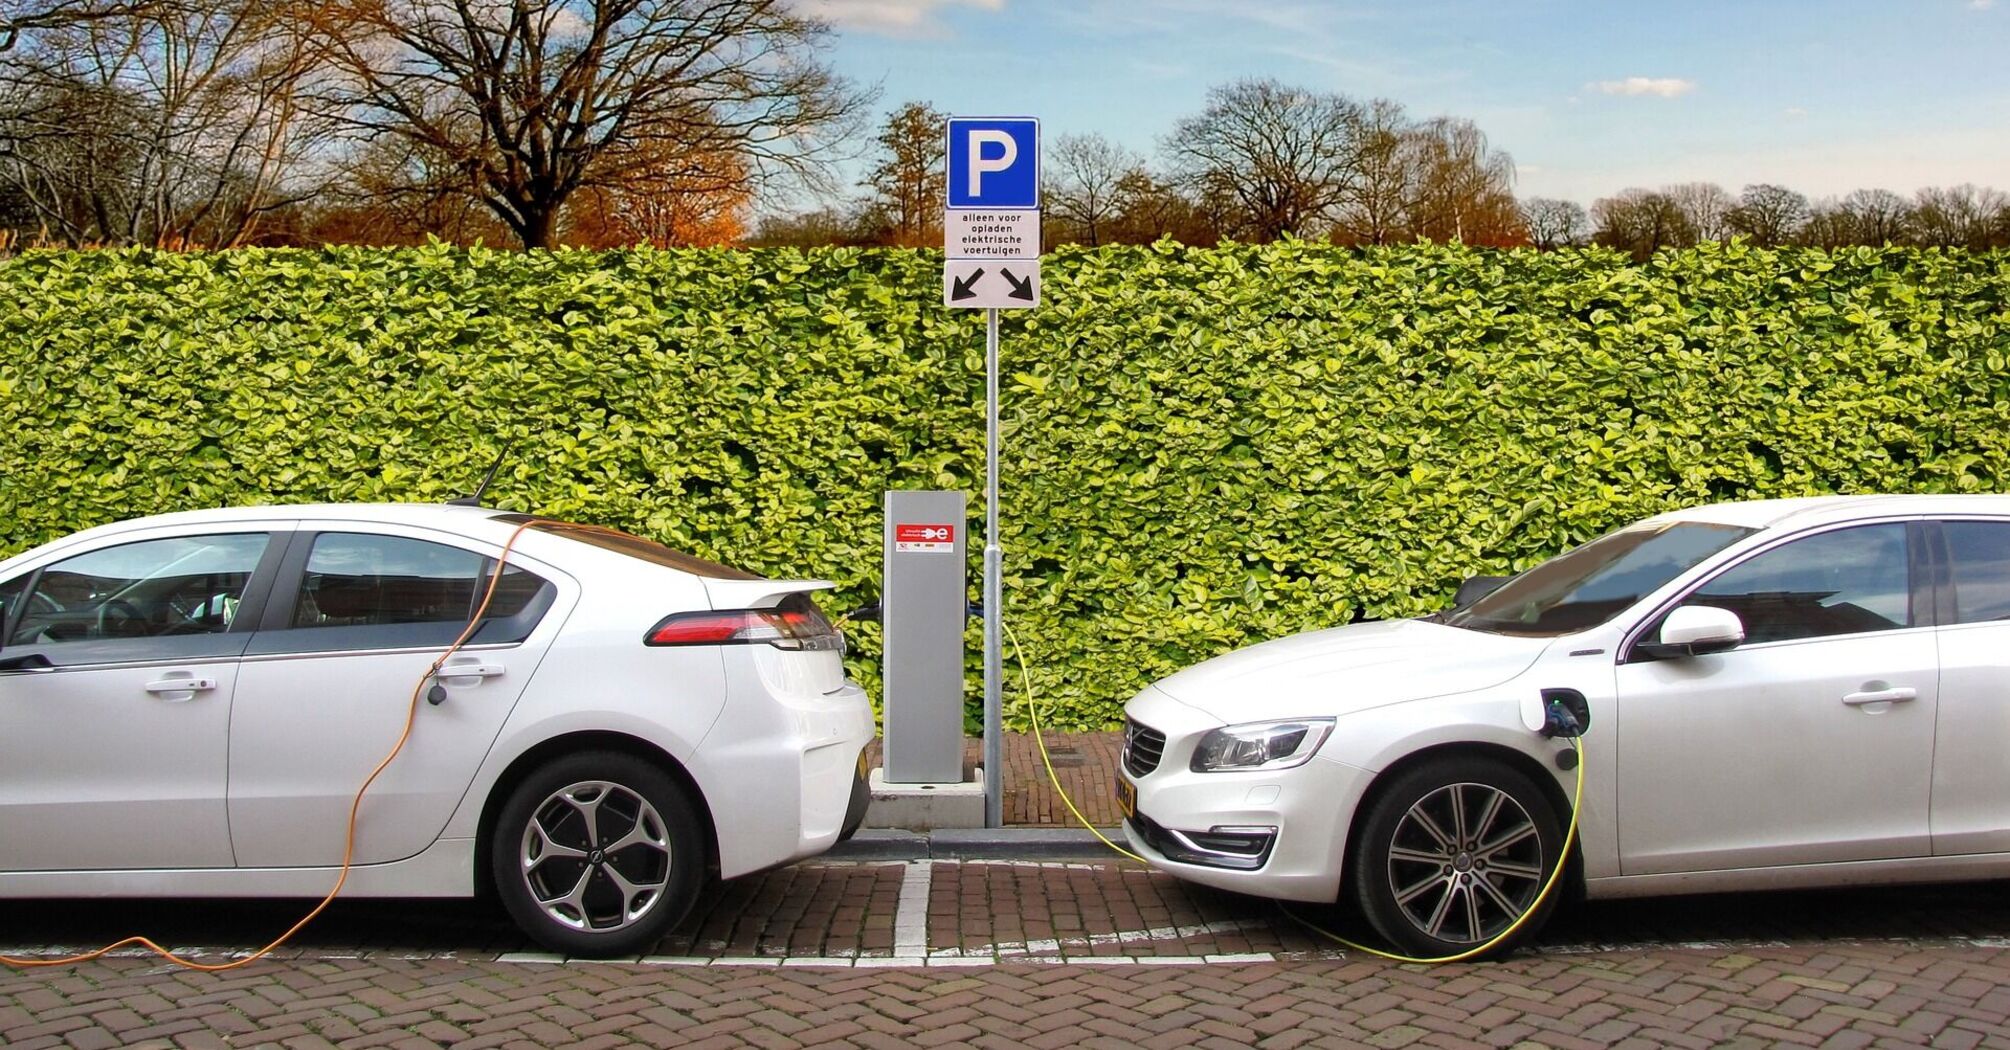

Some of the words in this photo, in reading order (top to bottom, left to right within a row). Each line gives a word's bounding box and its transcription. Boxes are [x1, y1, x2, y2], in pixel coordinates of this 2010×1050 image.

[968, 129, 1018, 198] P
[962, 213, 995, 222] alleen
[998, 214, 1022, 222] voor
[971, 224, 1013, 234] opladen
[961, 235, 1022, 244] elektrische
[963, 245, 1021, 256] voertuigen
